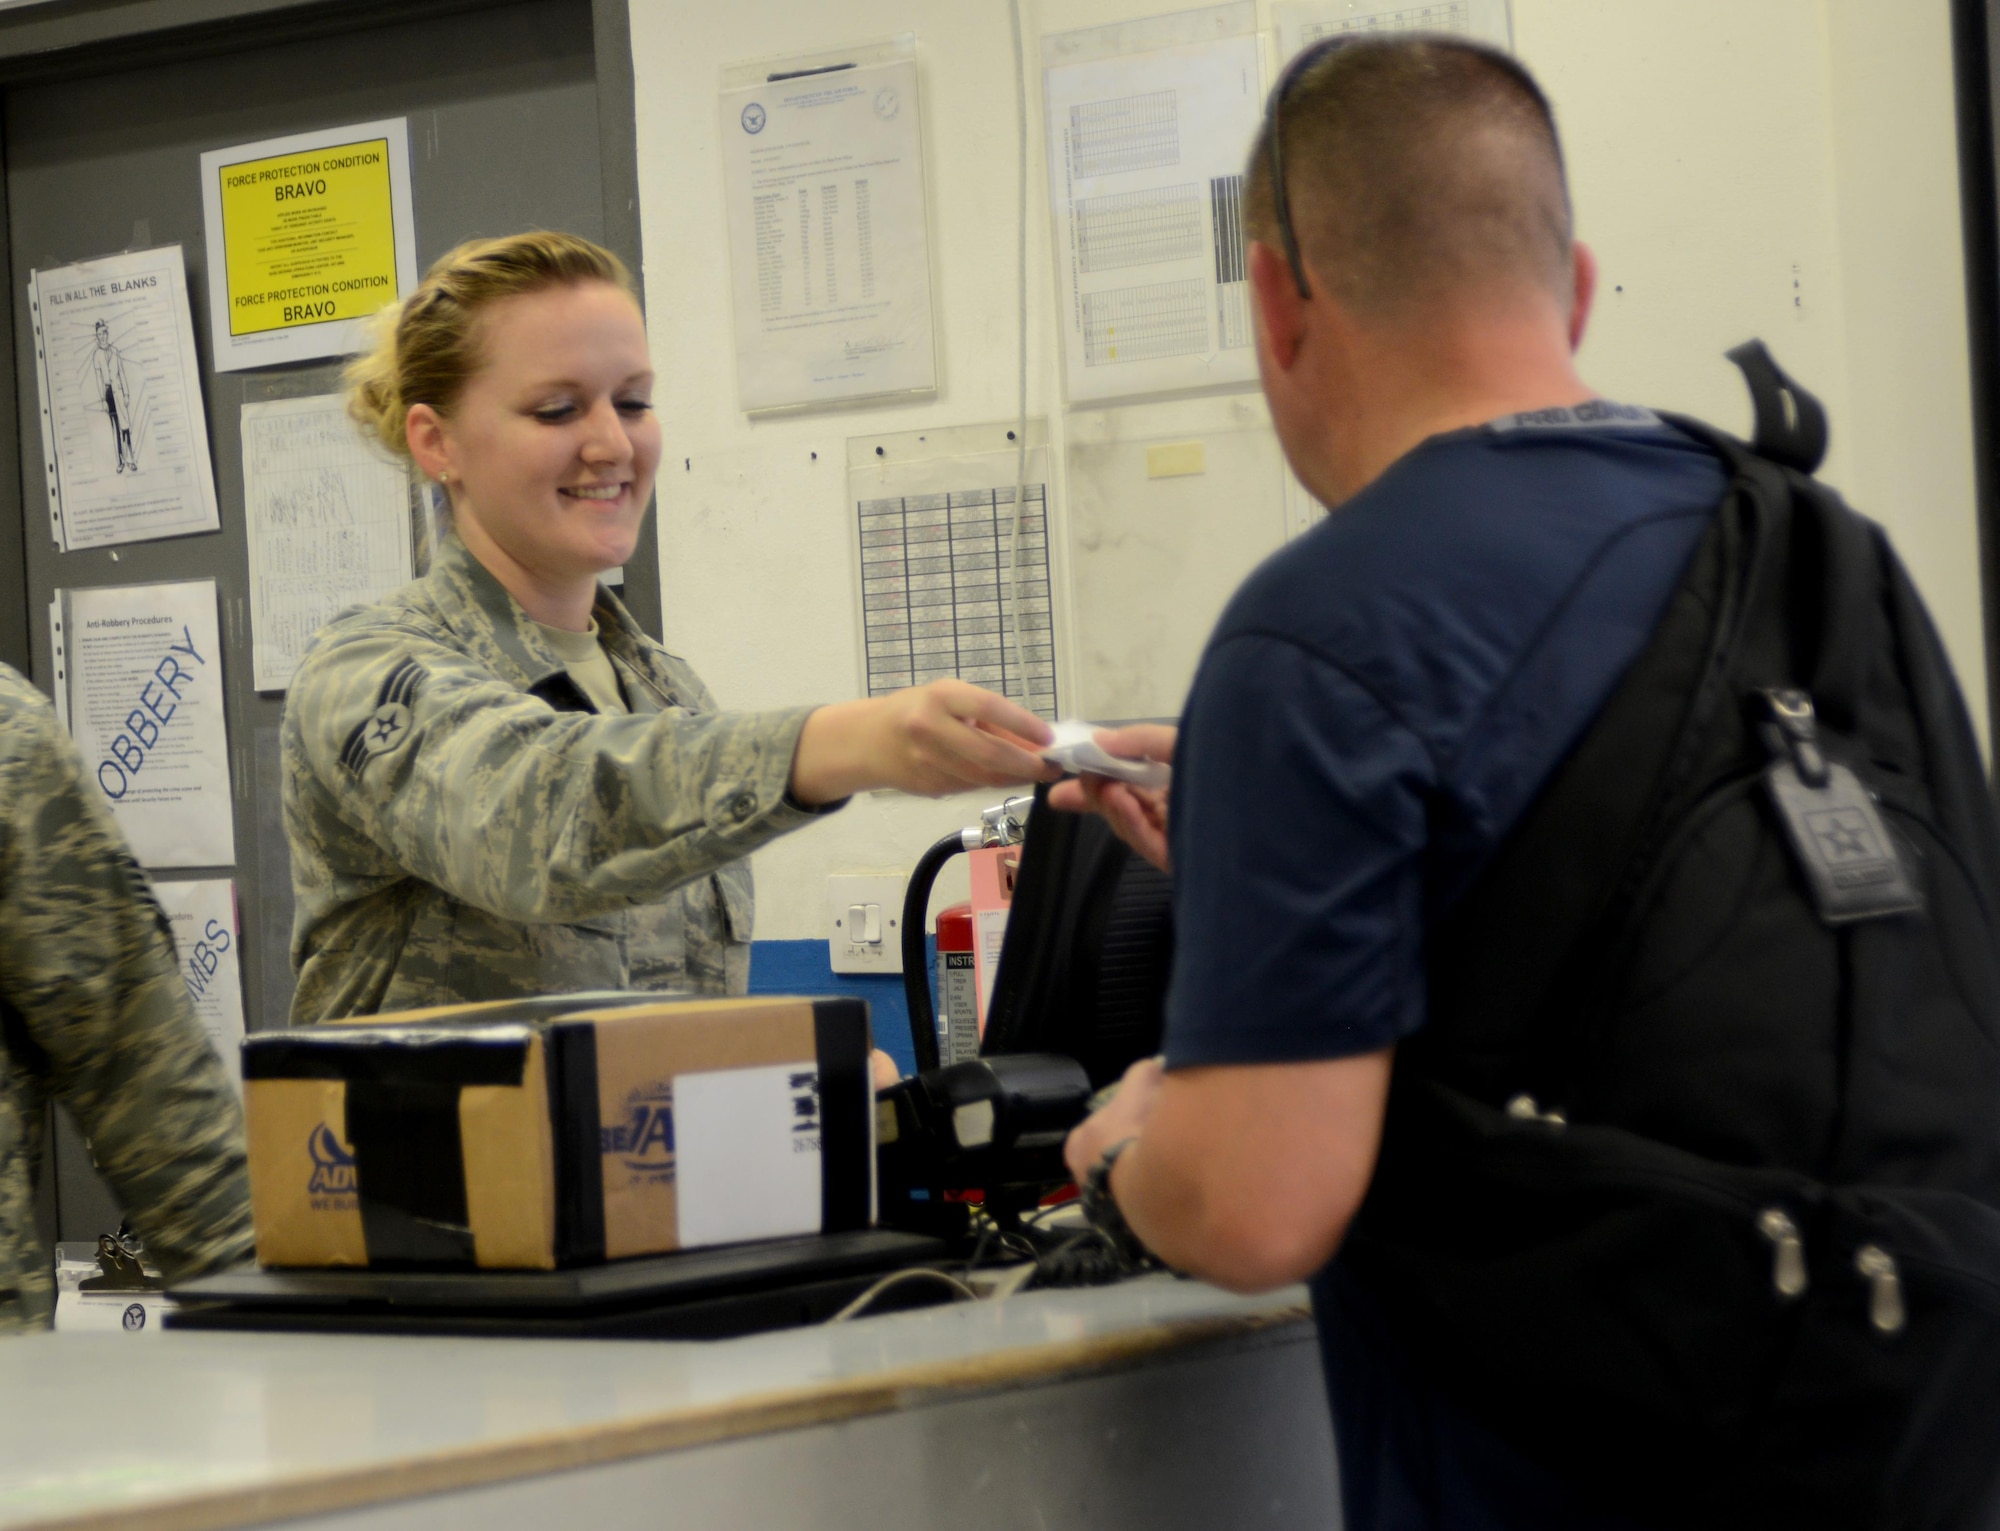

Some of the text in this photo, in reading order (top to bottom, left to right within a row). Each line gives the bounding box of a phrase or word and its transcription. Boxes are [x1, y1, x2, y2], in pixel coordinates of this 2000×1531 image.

[227, 153, 380, 188] FORCE PROTECTION CONDITION
[275, 179, 326, 201] BRAVO
[49, 294, 64, 306] FILL
[65, 292, 73, 303] IN
[73, 289, 88, 301] ALL
[90, 285, 107, 298] THE
[110, 276, 157, 294] BLANKS
[235, 275, 388, 307] FORCE PROTECTION CONDITION
[283, 300, 336, 321] BRAVO
[86, 615, 173, 629] Anti-Robbery Procedures
[98, 624, 206, 800] OBBERY
